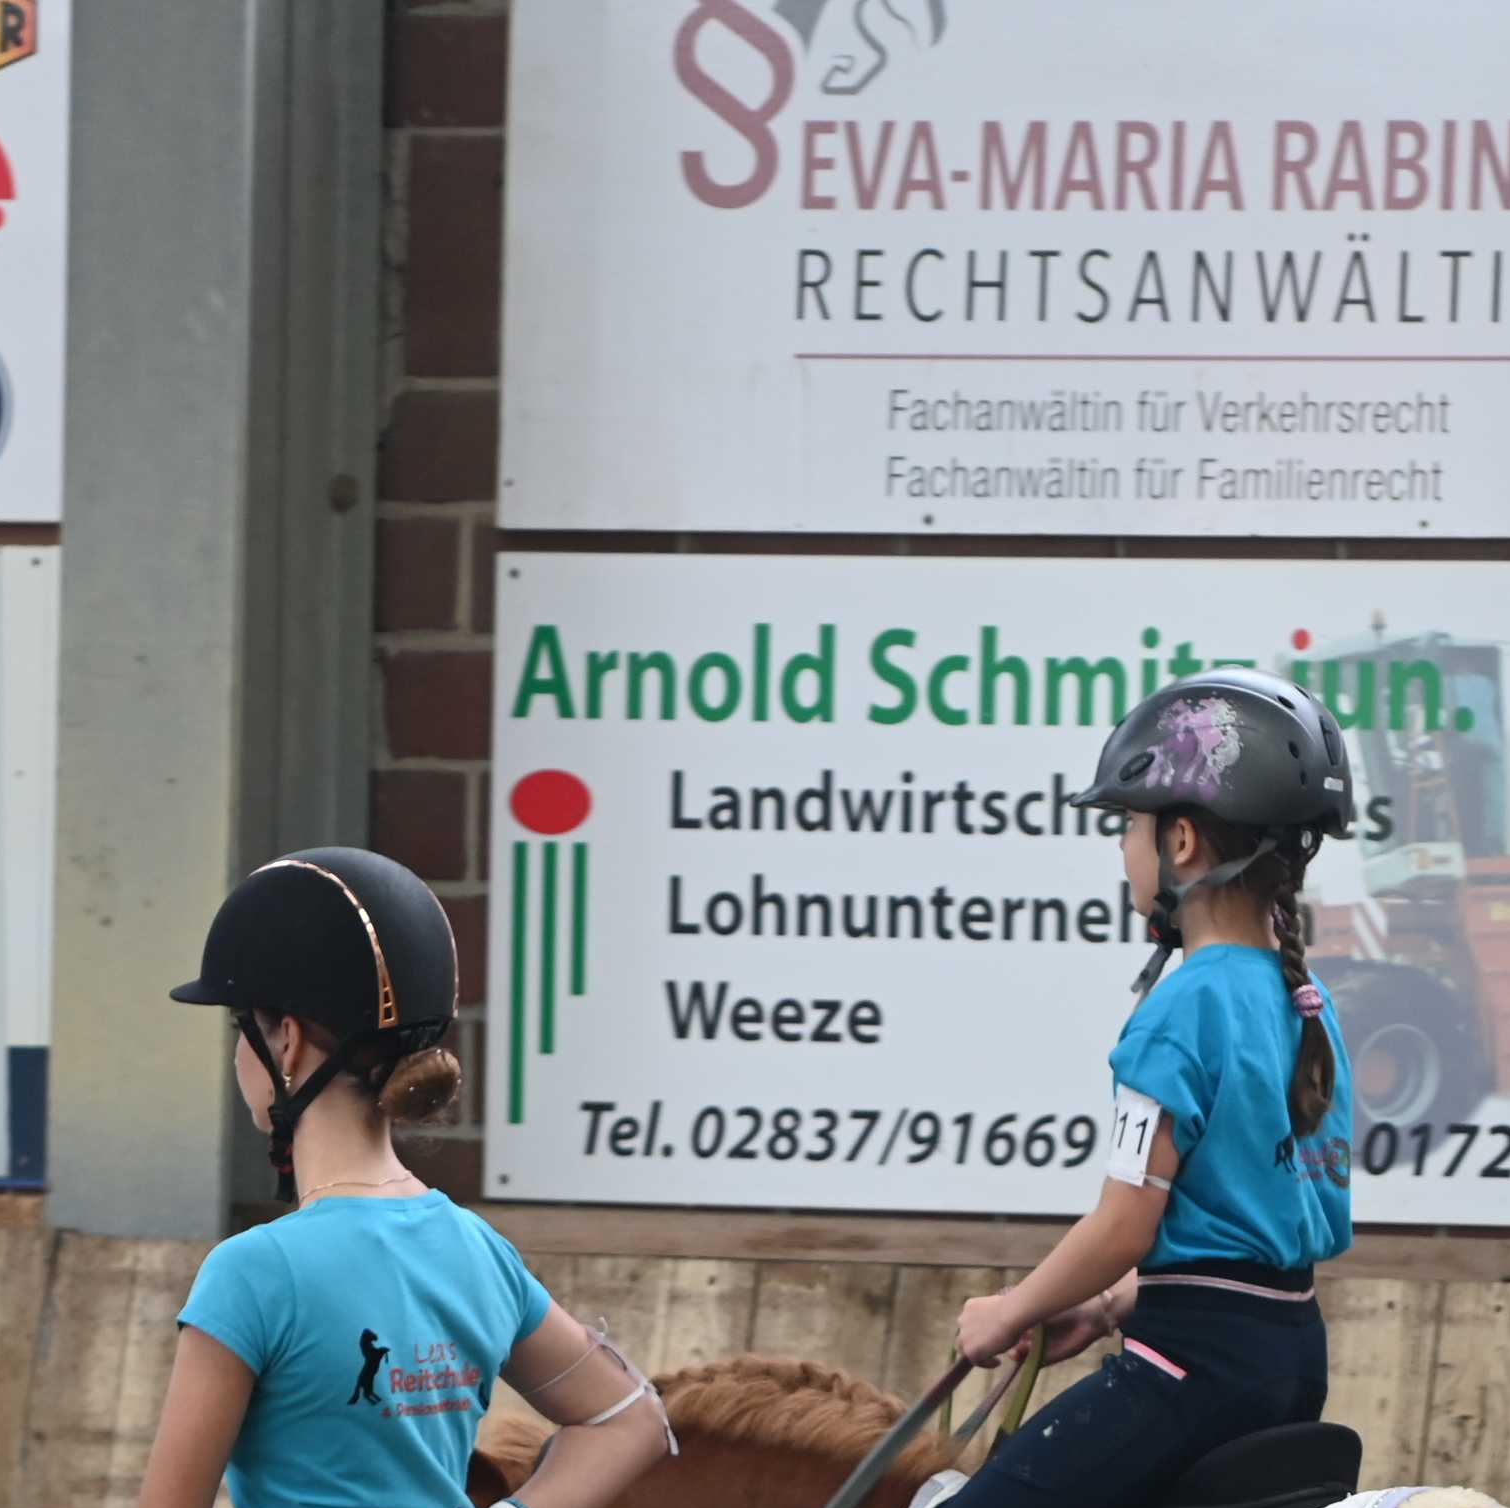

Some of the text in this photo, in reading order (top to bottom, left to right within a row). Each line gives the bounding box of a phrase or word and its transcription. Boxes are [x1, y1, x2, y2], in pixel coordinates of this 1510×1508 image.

[799, 119, 1244, 212] EVA-MARIA
[886, 389, 1451, 436] Fachanwältin für Verkehrsrecht
[884, 456, 1444, 503] Fachanwältin für Familienrecht
[511, 622, 836, 723] Arnold
[664, 980, 884, 1044] Weeze
[579, 1101, 675, 1158] Tel.
